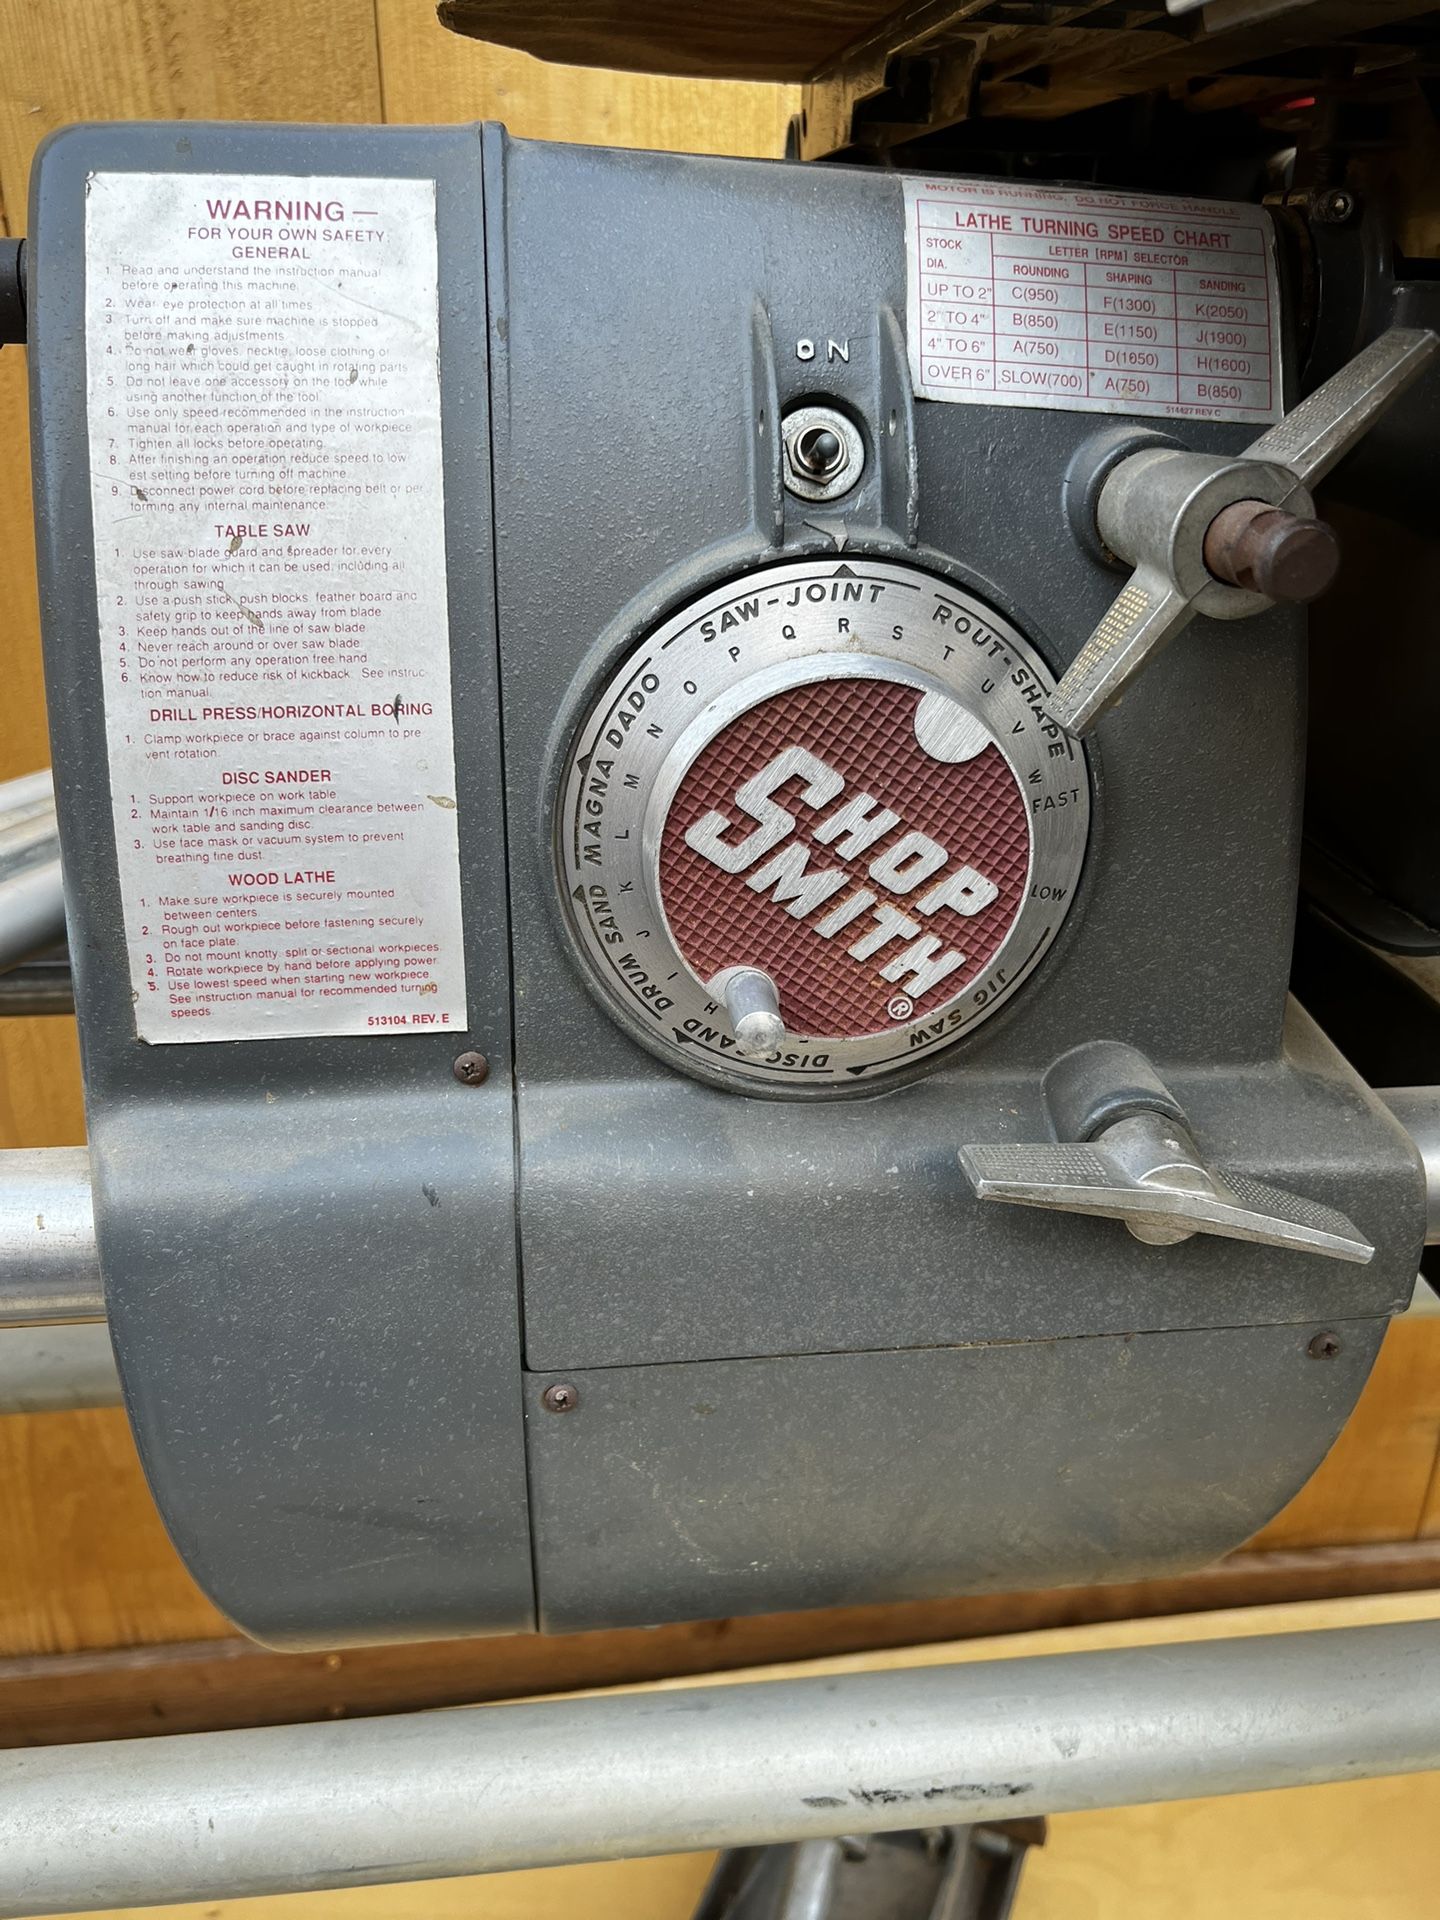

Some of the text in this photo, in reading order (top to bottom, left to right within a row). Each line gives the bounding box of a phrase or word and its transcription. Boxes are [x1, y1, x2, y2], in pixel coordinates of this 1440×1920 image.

[206, 199, 344, 221] WARNING
[188, 227, 385, 242] FOR YOUR OWN SAFETY
[955, 212, 1232, 249] LATHE TURNING SPEED CHART
[926, 238, 962, 250] STOCK
[232, 246, 311, 260] GENERAL
[1049, 245, 1088, 258] LETTER
[1133, 252, 1189, 266] SELECTOR
[927, 257, 947, 269] DIA.
[1013, 264, 1070, 279] ROUNDING
[1106, 272, 1153, 285] SHAPING
[1199, 279, 1246, 293] SANDING
[927, 282, 992, 300] UP TO 2"
[1011, 286, 1059, 305] C(950)
[1103, 296, 1156, 315] F(1300)
[1195, 303, 1248, 320] K(2050)
[946, 311, 967, 325] TO
[971, 313, 985, 326] 4"
[1012, 313, 1059, 331] B(850)
[1103, 323, 1158, 341] E(1150)
[1196, 330, 1247, 347] J(1900)
[796, 339, 850, 363] ON
[927, 337, 986, 353] 4" TO 6"
[1012, 340, 1059, 358] A(750)
[927, 364, 991, 382] OVER 6"
[1197, 357, 1251, 375] H(1600)
[1001, 369, 1082, 391] SLOW(700)
[1105, 377, 1150, 396] A(750)
[1198, 384, 1242, 400] B(850)
[127, 407, 150, 417] Use
[154, 407, 179, 420] only
[183, 407, 219, 420] speed
[223, 407, 306, 417] recommended
[310, 408, 320, 417] in
[324, 408, 343, 417] the
[346, 408, 405, 417] instruction
[128, 438, 172, 451] Tighten
[177, 438, 189, 449] all
[194, 438, 223, 449] locks
[228, 438, 265, 449] before
[215, 524, 311, 538] TABLE SAW
[700, 582, 885, 643] SAW-JOINT
[782, 625, 797, 640] Q
[838, 618, 850, 633] R
[892, 626, 904, 640] S
[138, 642, 172, 652] Never
[177, 642, 209, 652] reach
[213, 641, 254, 651] around
[257, 641, 269, 650] or
[273, 641, 297, 649] over
[302, 640, 325, 649] saw
[329, 639, 360, 649] blade
[943, 645, 955, 661] T
[139, 657, 155, 668] Do
[159, 657, 177, 667] not
[181, 657, 227, 670] perform
[230, 657, 251, 670] any
[255, 655, 309, 668] operation
[313, 654, 335, 664] free
[339, 653, 367, 663] hand
[728, 646, 741, 663] P
[683, 680, 697, 695] O
[932, 604, 1065, 758] ROUT-SHAPE
[981, 679, 995, 694] U
[150, 702, 433, 722] DRILL PRESS/HORIZONTAL BORING
[646, 723, 664, 739] N
[1011, 720, 1026, 735] V
[222, 769, 331, 785] DISC SANDER
[584, 673, 660, 866] MAGNA DADO
[1028, 769, 1042, 785] W
[623, 774, 640, 789] M
[130, 790, 337, 807] 1. Support workpiece on work table
[1032, 788, 1080, 814] FAST
[131, 802, 424, 819] 2. Maintain 1/16 inch maximum clearance between
[615, 829, 629, 841] L
[685, 746, 999, 917] SHOP
[229, 870, 336, 886] WOOD LATHE
[685, 746, 966, 999] SMITH
[620, 881, 634, 893] K
[1030, 884, 1068, 901] LOW
[141, 889, 395, 907] 1. Make sure workpiece is securely mounted
[164, 910, 212, 921] between
[146, 954, 156, 964] 3.
[165, 952, 181, 963] Do
[185, 951, 203, 961] not
[206, 951, 241, 961] mount
[285, 948, 308, 958] split
[312, 948, 322, 956] or
[326, 945, 375, 955] sectional
[588, 884, 675, 1012] DRUM SAND
[909, 968, 1006, 1047] JIG SAW
[367, 1013, 449, 1026] 513104 REV. E
[683, 1017, 830, 1068] DISC AND
